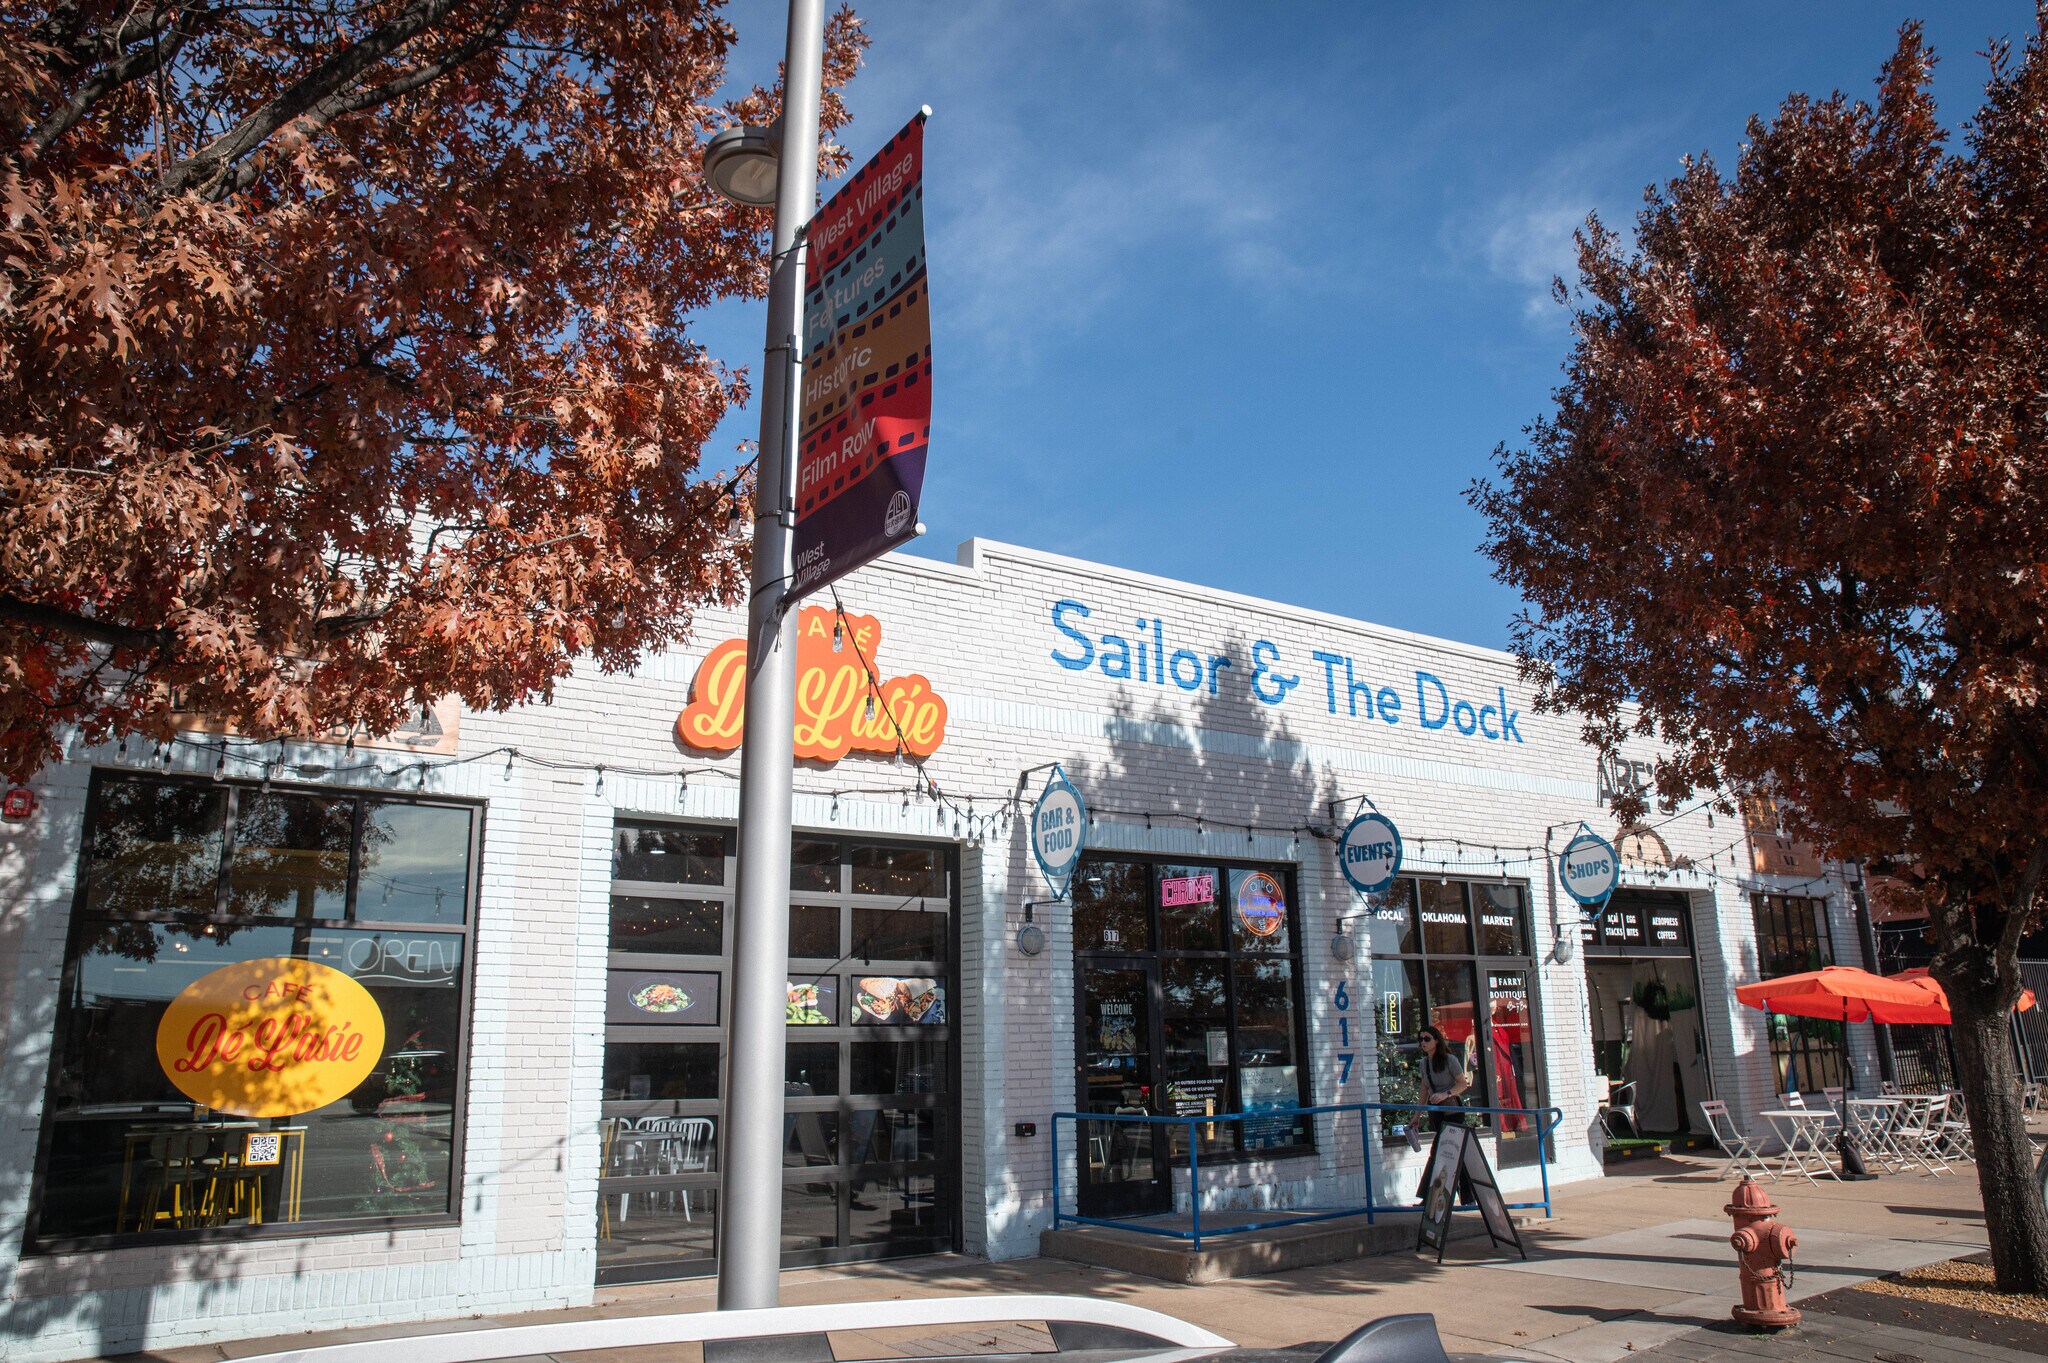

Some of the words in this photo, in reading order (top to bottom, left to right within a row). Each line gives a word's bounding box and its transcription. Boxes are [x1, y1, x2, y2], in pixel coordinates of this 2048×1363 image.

[813, 206, 854, 257] West
[856, 153, 913, 217] Village
[809, 257, 885, 338] Features
[805, 346, 872, 407] Historic
[801, 450, 837, 492] Film
[841, 416, 877, 464] Row
[797, 541, 825, 570] West
[795, 558, 831, 591] Village
[1050, 599, 1232, 695] Sailor
[1251, 639, 1300, 706] &
[1313, 649, 1401, 725] The
[1415, 670, 1524, 744] Dock
[1041, 806, 1063, 832] BAR
[1065, 807, 1075, 825] &
[1044, 828, 1073, 854] FOOD
[1347, 841, 1394, 864] EVENTS
[1568, 858, 1610, 880] SHOPS
[1163, 878, 1212, 904] CHROME
[1376, 910, 1405, 921] LOCAL
[1421, 912, 1467, 925] OKLAHOMA
[1482, 915, 1513, 927] MARKET
[1652, 916, 1679, 927] AEROPRESS
[1104, 929, 1119, 941] 617
[1605, 927, 1623, 937] STACKS
[1656, 931, 1677, 940] COFFEES
[348, 937, 456, 974] OPEN
[242, 980, 314, 1005] CAFÉ
[1498, 977, 1522, 986] FARRY
[1489, 990, 1527, 1000] BOUTIQUE
[1100, 1003, 1133, 1015] WELCOME
[1389, 992, 1397, 1032] OPEN
[173, 1012, 253, 1073] Dé
[1334, 981, 1355, 1085] 617
